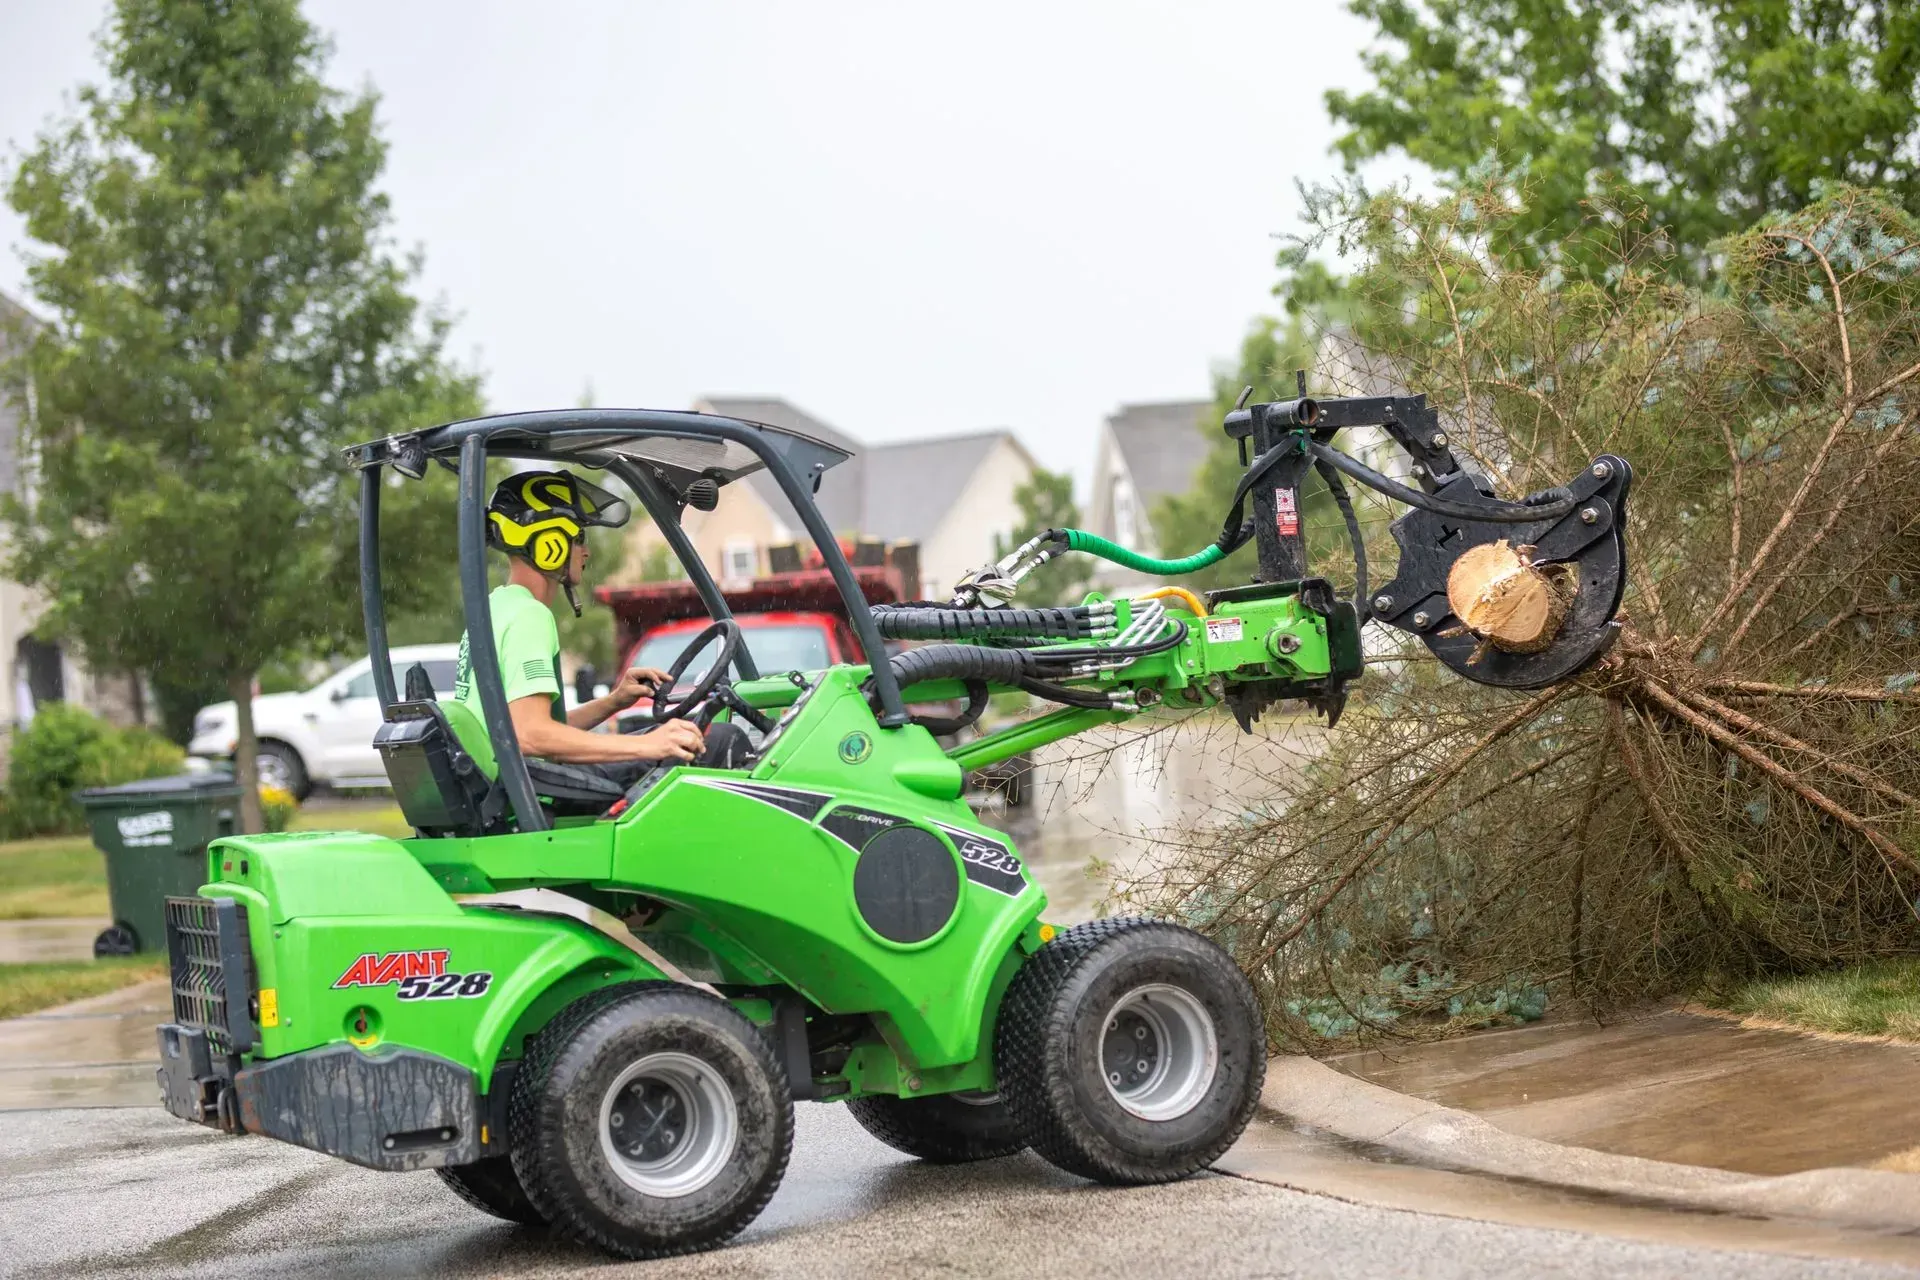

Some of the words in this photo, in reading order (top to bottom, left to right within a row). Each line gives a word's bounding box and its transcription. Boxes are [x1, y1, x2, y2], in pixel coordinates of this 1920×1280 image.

[831, 809, 894, 827] OPTIDRIVE
[960, 840, 1021, 876] 528
[332, 949, 450, 989] AVANT
[397, 972, 493, 1001] 528
